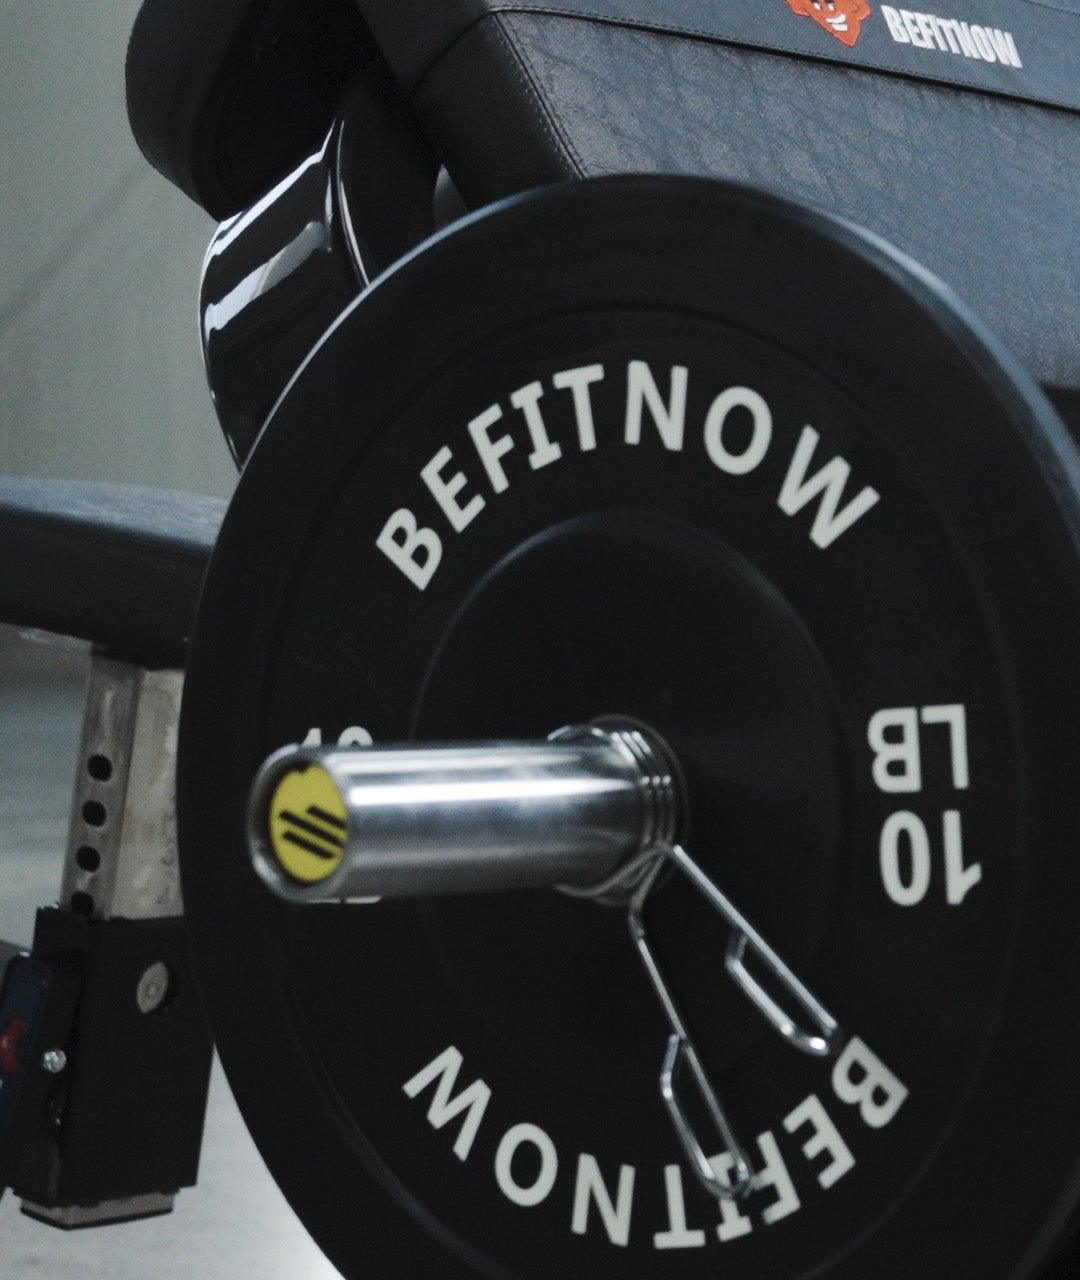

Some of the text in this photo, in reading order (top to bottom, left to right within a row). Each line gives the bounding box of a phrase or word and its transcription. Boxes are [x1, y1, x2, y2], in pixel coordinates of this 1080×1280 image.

[880, 4, 1023, 69] BEFITNOW
[375, 359, 880, 591] BEFITNOW
[867, 703, 969, 794] LB
[879, 809, 983, 907] 10
[403, 1036, 909, 1250] BEFITNOW
